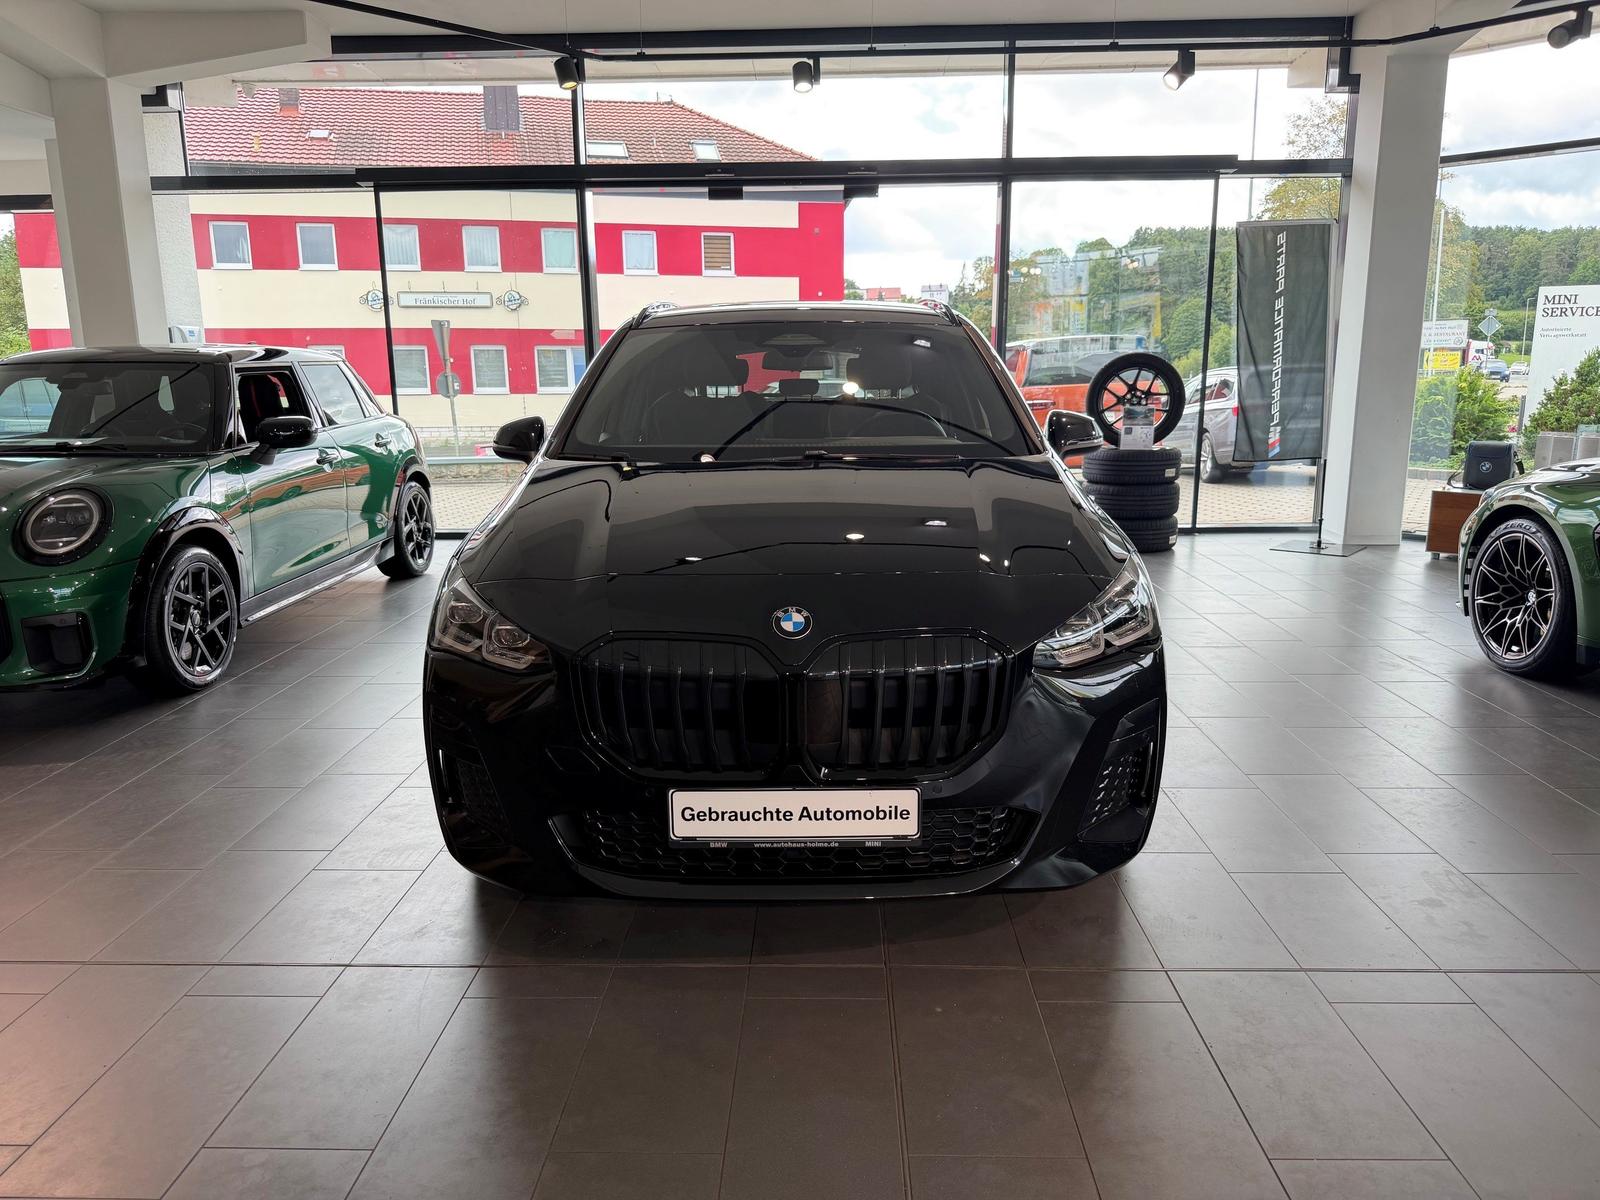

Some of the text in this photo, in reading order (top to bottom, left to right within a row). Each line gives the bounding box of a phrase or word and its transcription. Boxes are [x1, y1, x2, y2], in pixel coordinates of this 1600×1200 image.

[414, 297, 476, 305] Fränkischer Hof
[1543, 294, 1579, 305] MINI
[1542, 306, 1600, 318] SERVICE
[1502, 522, 1532, 531] ZERO
[680, 805, 911, 822] Gebrauchte Automobile
